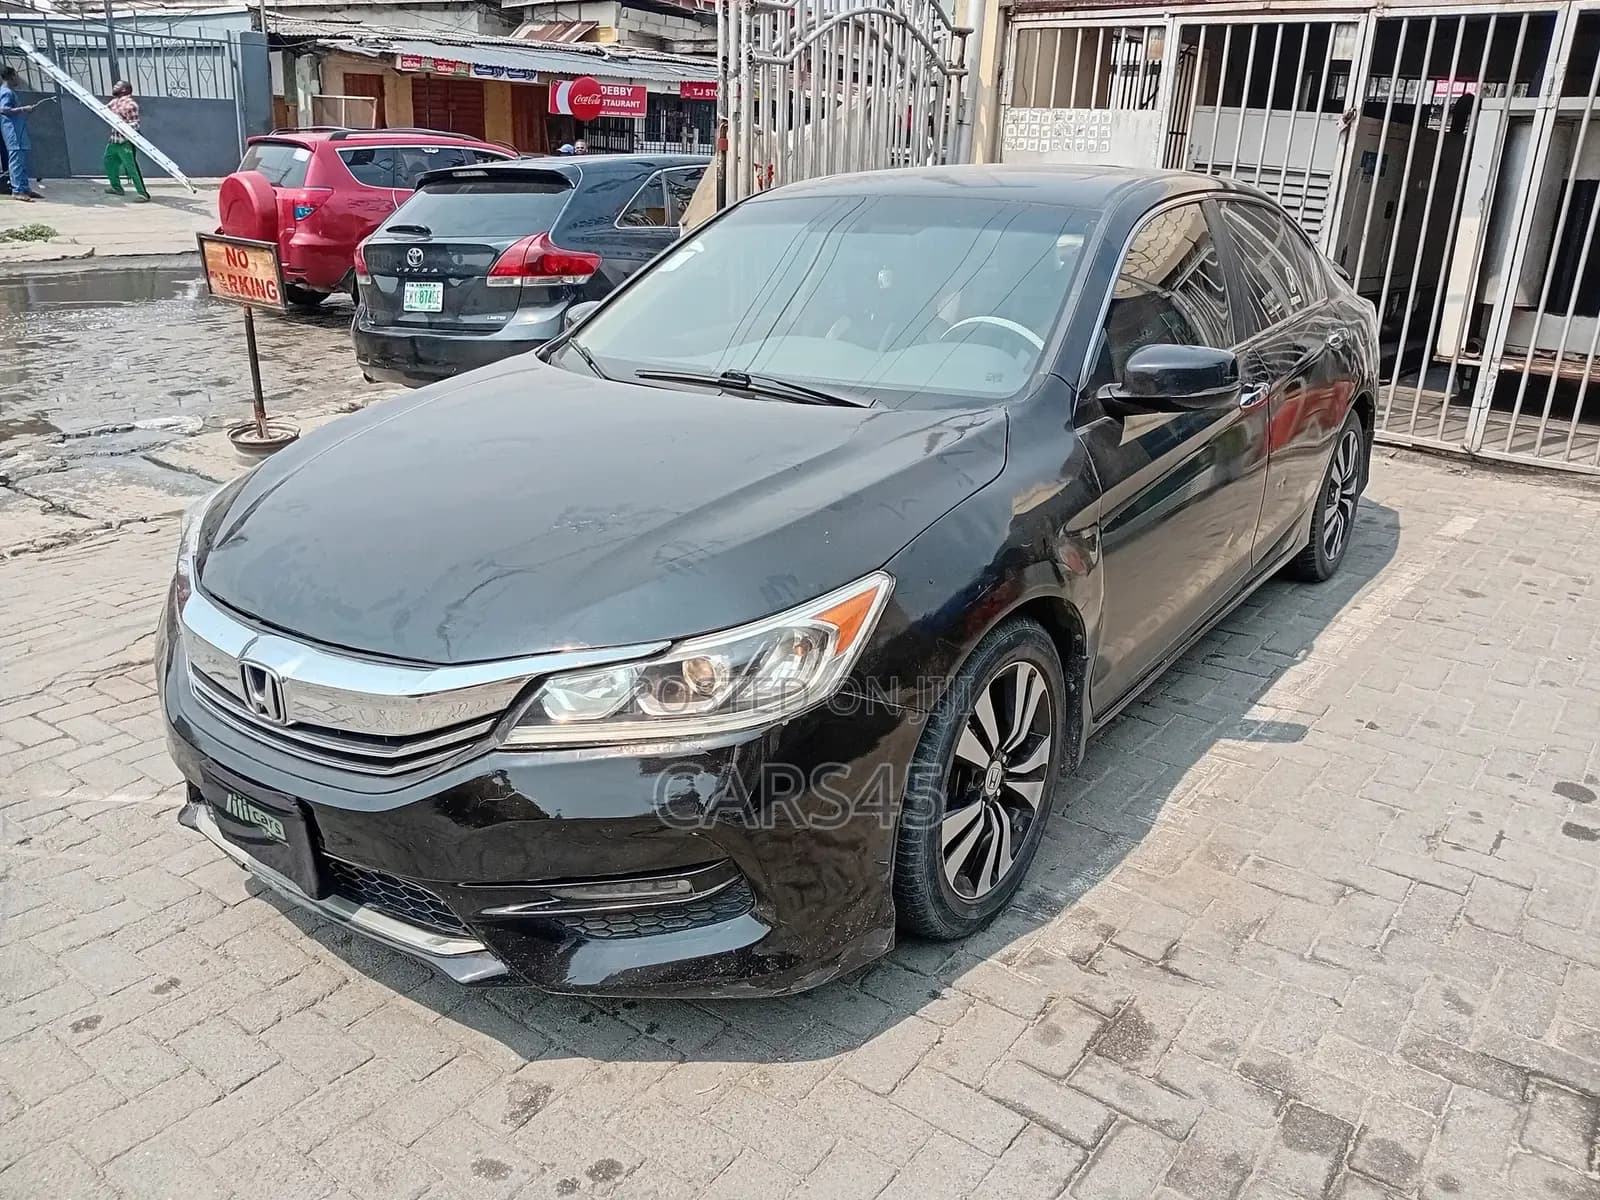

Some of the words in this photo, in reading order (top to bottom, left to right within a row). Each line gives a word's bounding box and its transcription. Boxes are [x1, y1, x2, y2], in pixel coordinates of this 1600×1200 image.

[600, 85, 633, 96] DEBBY
[225, 246, 249, 269] NO
[252, 810, 283, 836] cars
